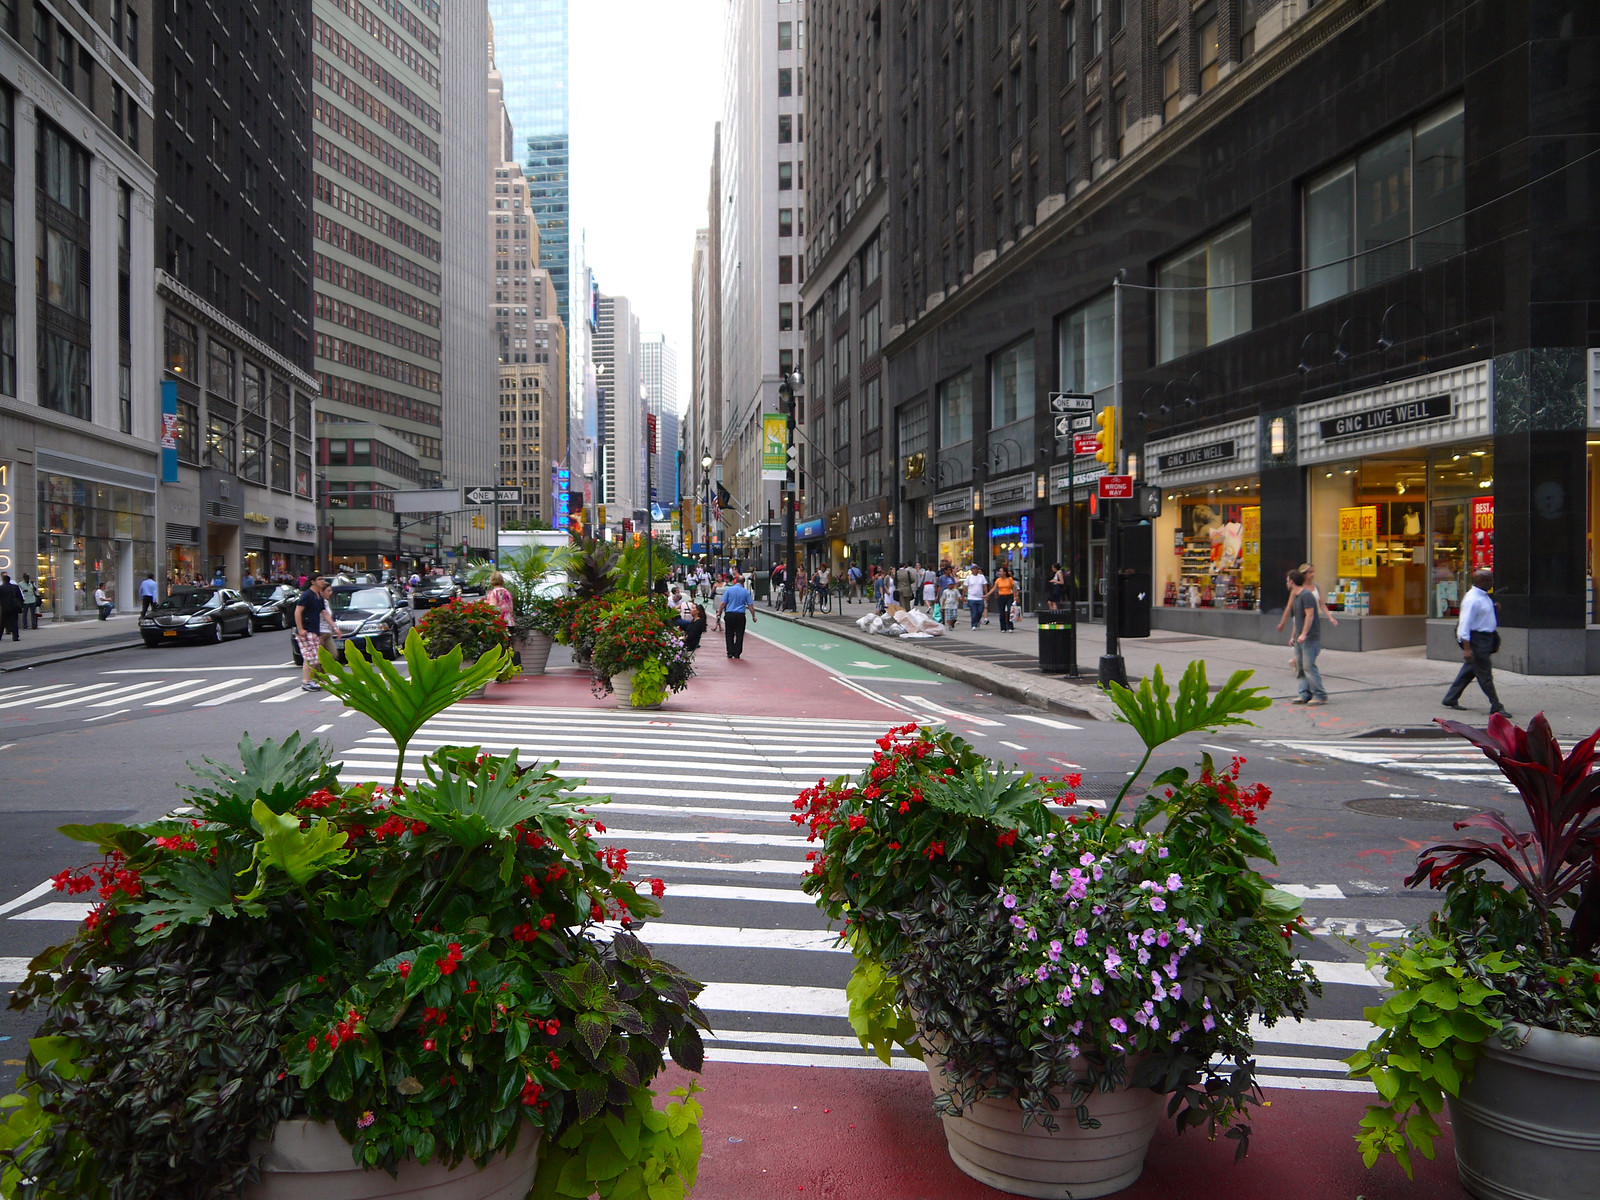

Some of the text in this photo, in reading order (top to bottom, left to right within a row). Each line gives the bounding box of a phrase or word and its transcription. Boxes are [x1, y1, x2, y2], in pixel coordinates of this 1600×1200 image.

[1057, 399, 1089, 408] ONE WAY
[1075, 419, 1088, 428] WAY
[1336, 402, 1430, 434] GNC LIVE WELL
[1167, 445, 1223, 467] GNC LIVE WELL
[472, 491, 515, 500] ONE WAY
[1475, 503, 1490, 514] BEST
[1360, 516, 1373, 530] OFF
